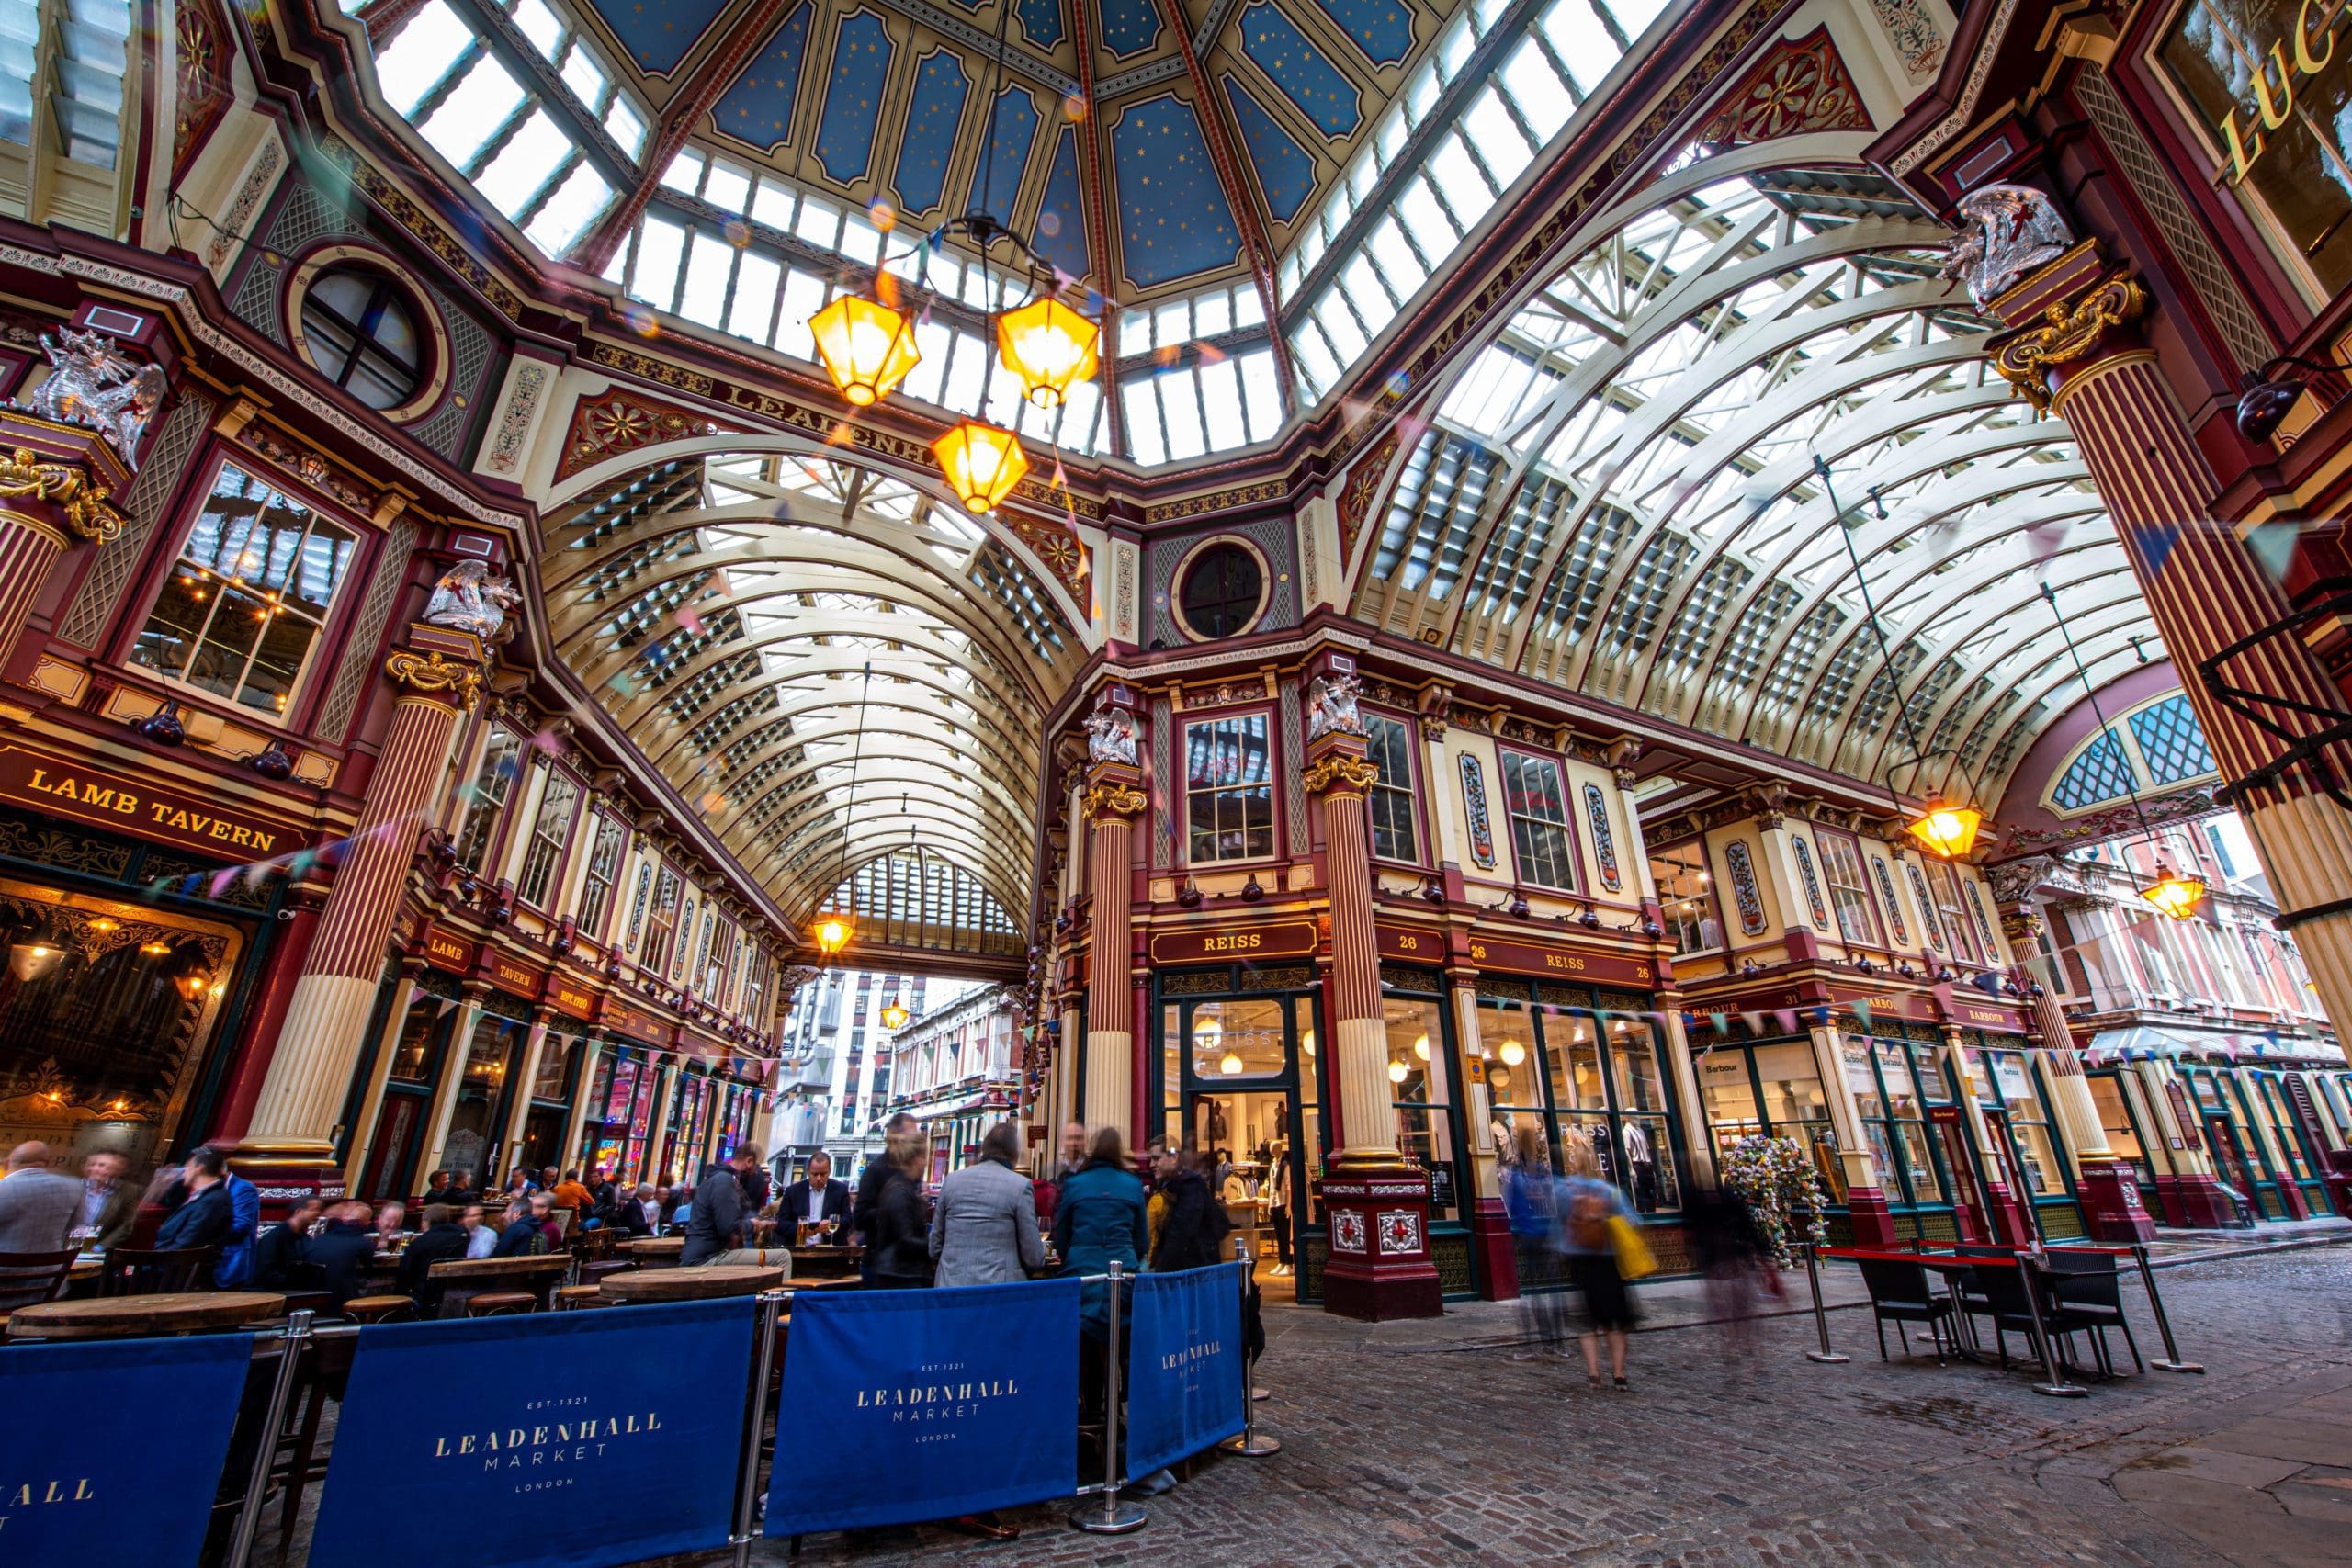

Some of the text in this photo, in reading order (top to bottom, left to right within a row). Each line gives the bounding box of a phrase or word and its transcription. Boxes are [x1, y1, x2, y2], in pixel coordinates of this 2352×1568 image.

[2220, 0, 2352, 185] LUC
[28, 769, 277, 852] LAMB TAVERN
[431, 939, 463, 961] LAMB
[1204, 934, 1261, 951] REISS
[1399, 936, 1417, 950] 26
[1471, 945, 1649, 979] 26 REISS 26
[500, 964, 531, 987] TAVERN
[1683, 994, 1799, 1018] RBOUR 31
[1926, 1004, 1934, 1014] 31
[1969, 1010, 2005, 1023] BARBOUR
[1705, 1064, 1737, 1074] Barbour
[1560, 1123, 1607, 1137] REISS
[921, 1362, 964, 1372] EST.1321
[526, 1395, 589, 1410] EST.1321
[855, 1379, 1019, 1408] LEADENHALL
[892, 1404, 979, 1422] MARKET
[434, 1412, 662, 1457] LEADENHALL
[914, 1433, 957, 1443] LONDON
[484, 1443, 607, 1472] MARKET
[0, 1478, 94, 1507] ALL
[514, 1478, 574, 1493] LONDON
